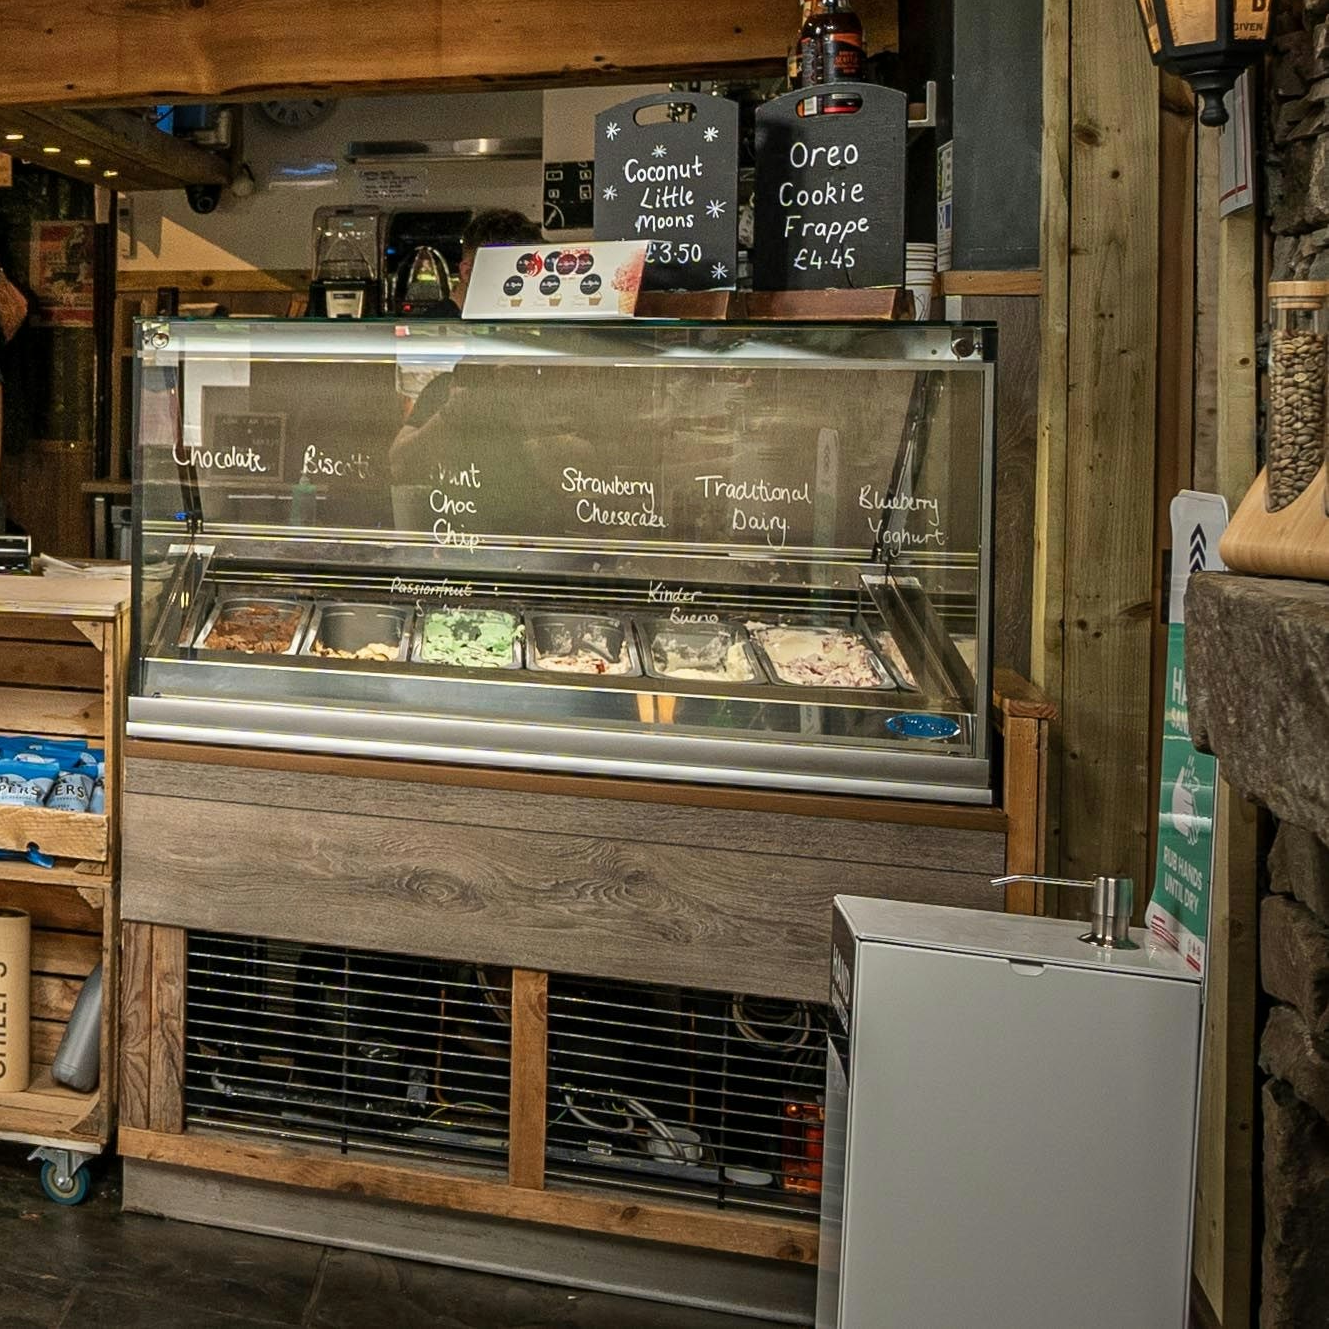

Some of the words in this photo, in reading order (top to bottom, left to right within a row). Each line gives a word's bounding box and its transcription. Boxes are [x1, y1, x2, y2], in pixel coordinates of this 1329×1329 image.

[790, 142, 859, 169] Oreo
[624, 156, 703, 183] Coconut
[640, 188, 695, 208] Little
[779, 181, 865, 205] Cookie
[635, 213, 695, 232] Moons
[785, 216, 870, 239] Frappe
[794, 247, 855, 270] £4.45
[172, 445, 267, 472] Chocolate
[429, 490, 477, 514] Choc
[561, 467, 655, 513] Strawberry
[694, 475, 813, 505] Traditional
[858, 485, 940, 526] Blueberry
[646, 581, 702, 603] Kinder
[670, 607, 719, 624] Bueno
[1163, 845, 1178, 869] RUB
[1179, 857, 1203, 892] HANDS
[1164, 871, 1184, 902] UNTIL
[1184, 891, 1200, 915] DRY
